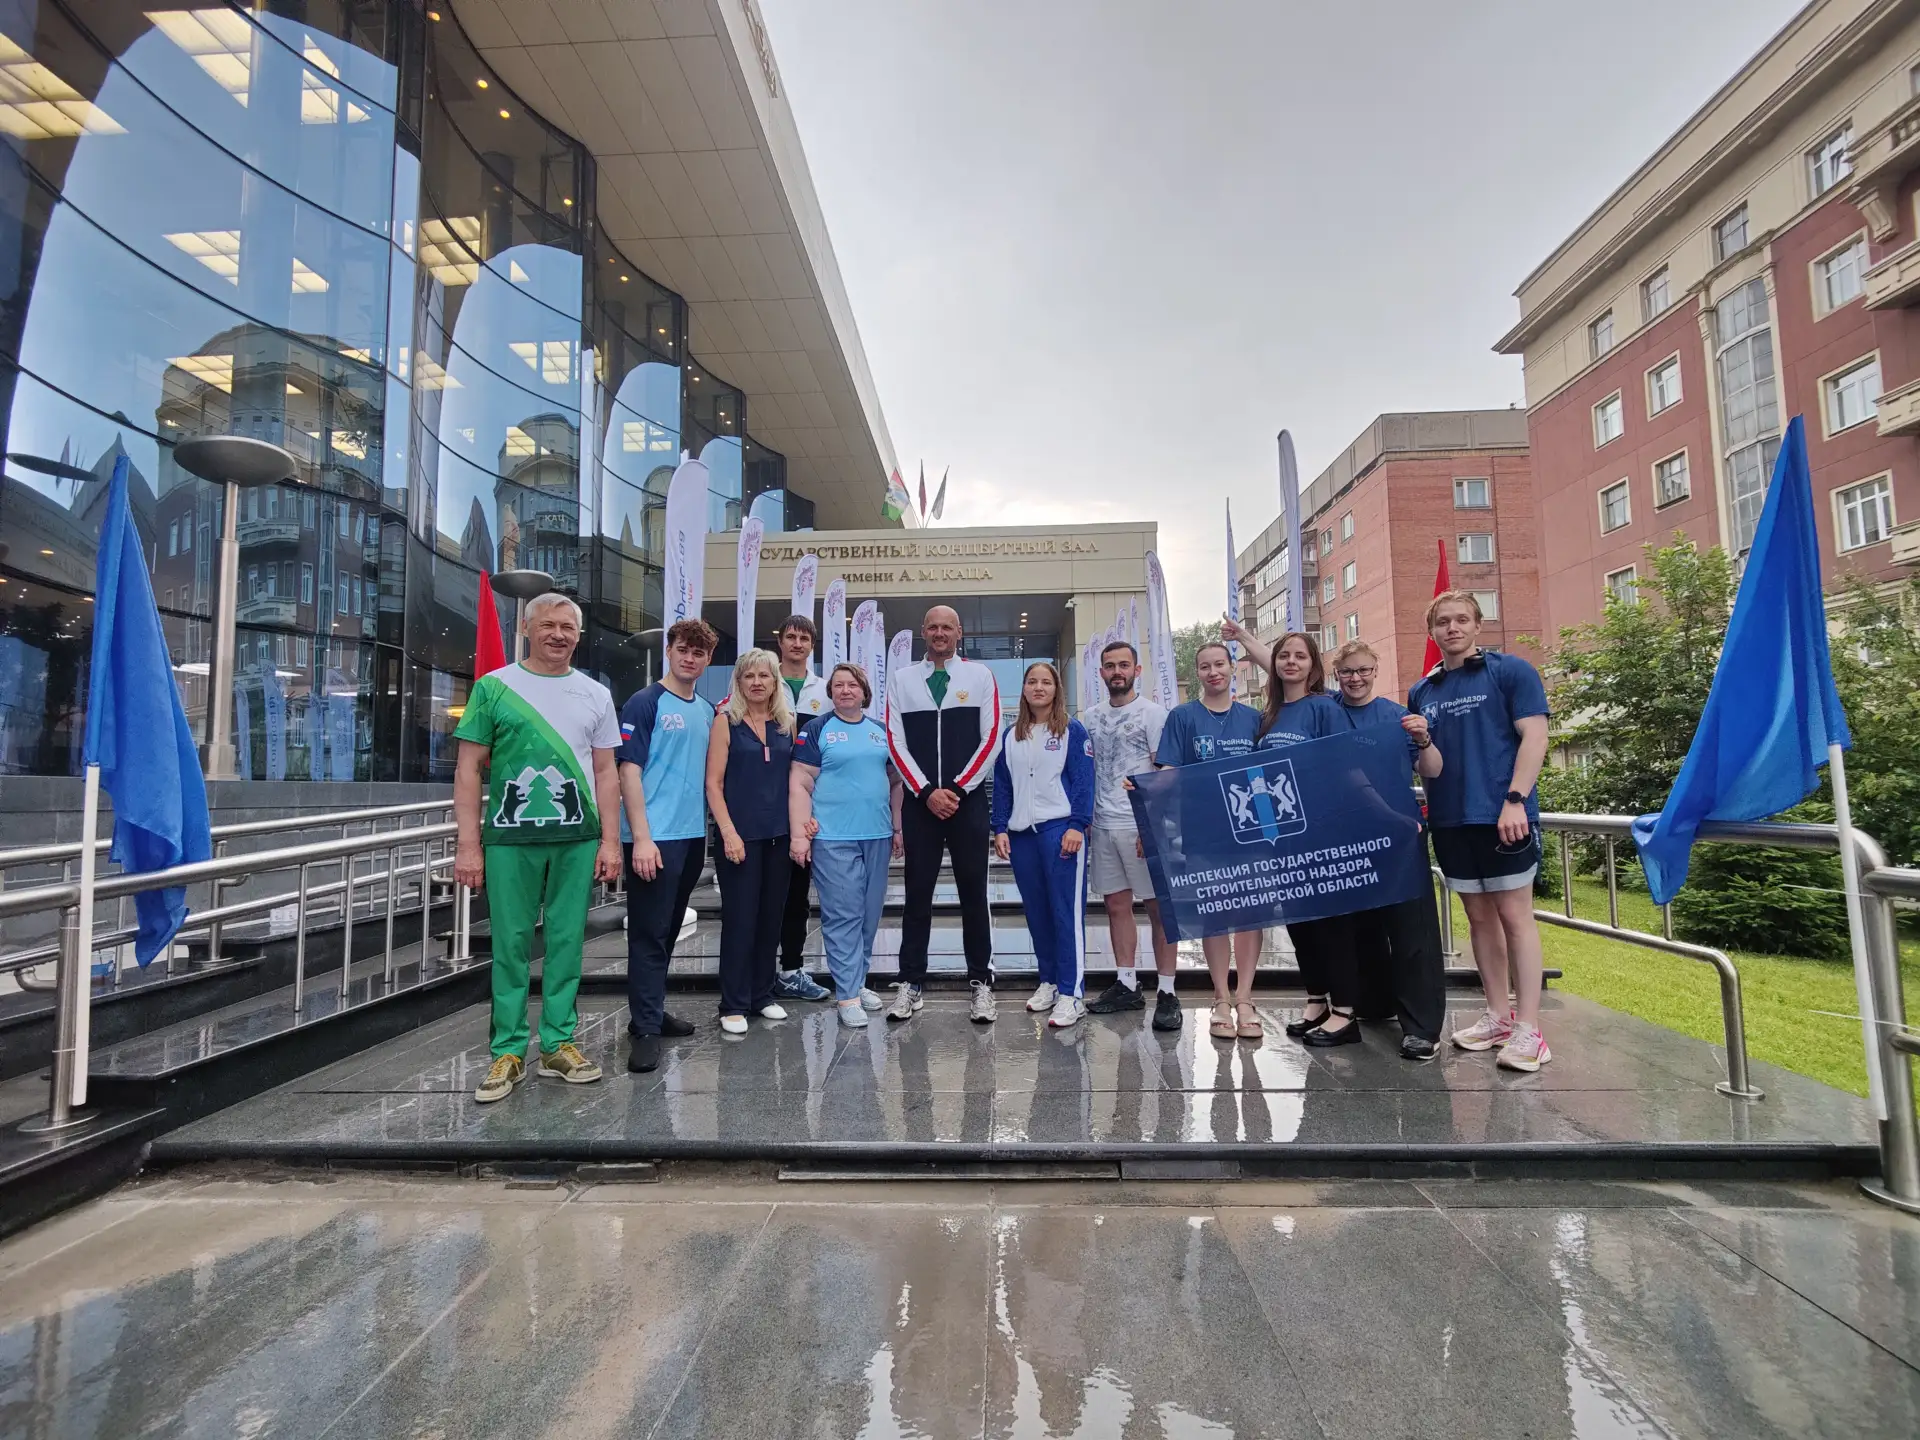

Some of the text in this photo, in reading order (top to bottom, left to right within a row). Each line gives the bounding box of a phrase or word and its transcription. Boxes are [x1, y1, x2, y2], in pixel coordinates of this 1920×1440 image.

[758, 540, 1099, 562] СУДАРСТВЕННЫЙ КОНЦЕРТНЫЙ ЗАЛ
[842, 572, 894, 583] имени
[941, 567, 993, 582] КАЦА
[660, 713, 685, 731] 29
[825, 731, 849, 744] 59
[1170, 836, 1392, 888] ИНСПЕКЦИЯ ГОСУДАРСТВЕННОГО
[1196, 857, 1373, 899] СТРОИТЕЛЬНОГО НАДЗОРА
[1197, 871, 1379, 915] НОВОСИБИРСКОЙ ОБЛАСТИ
